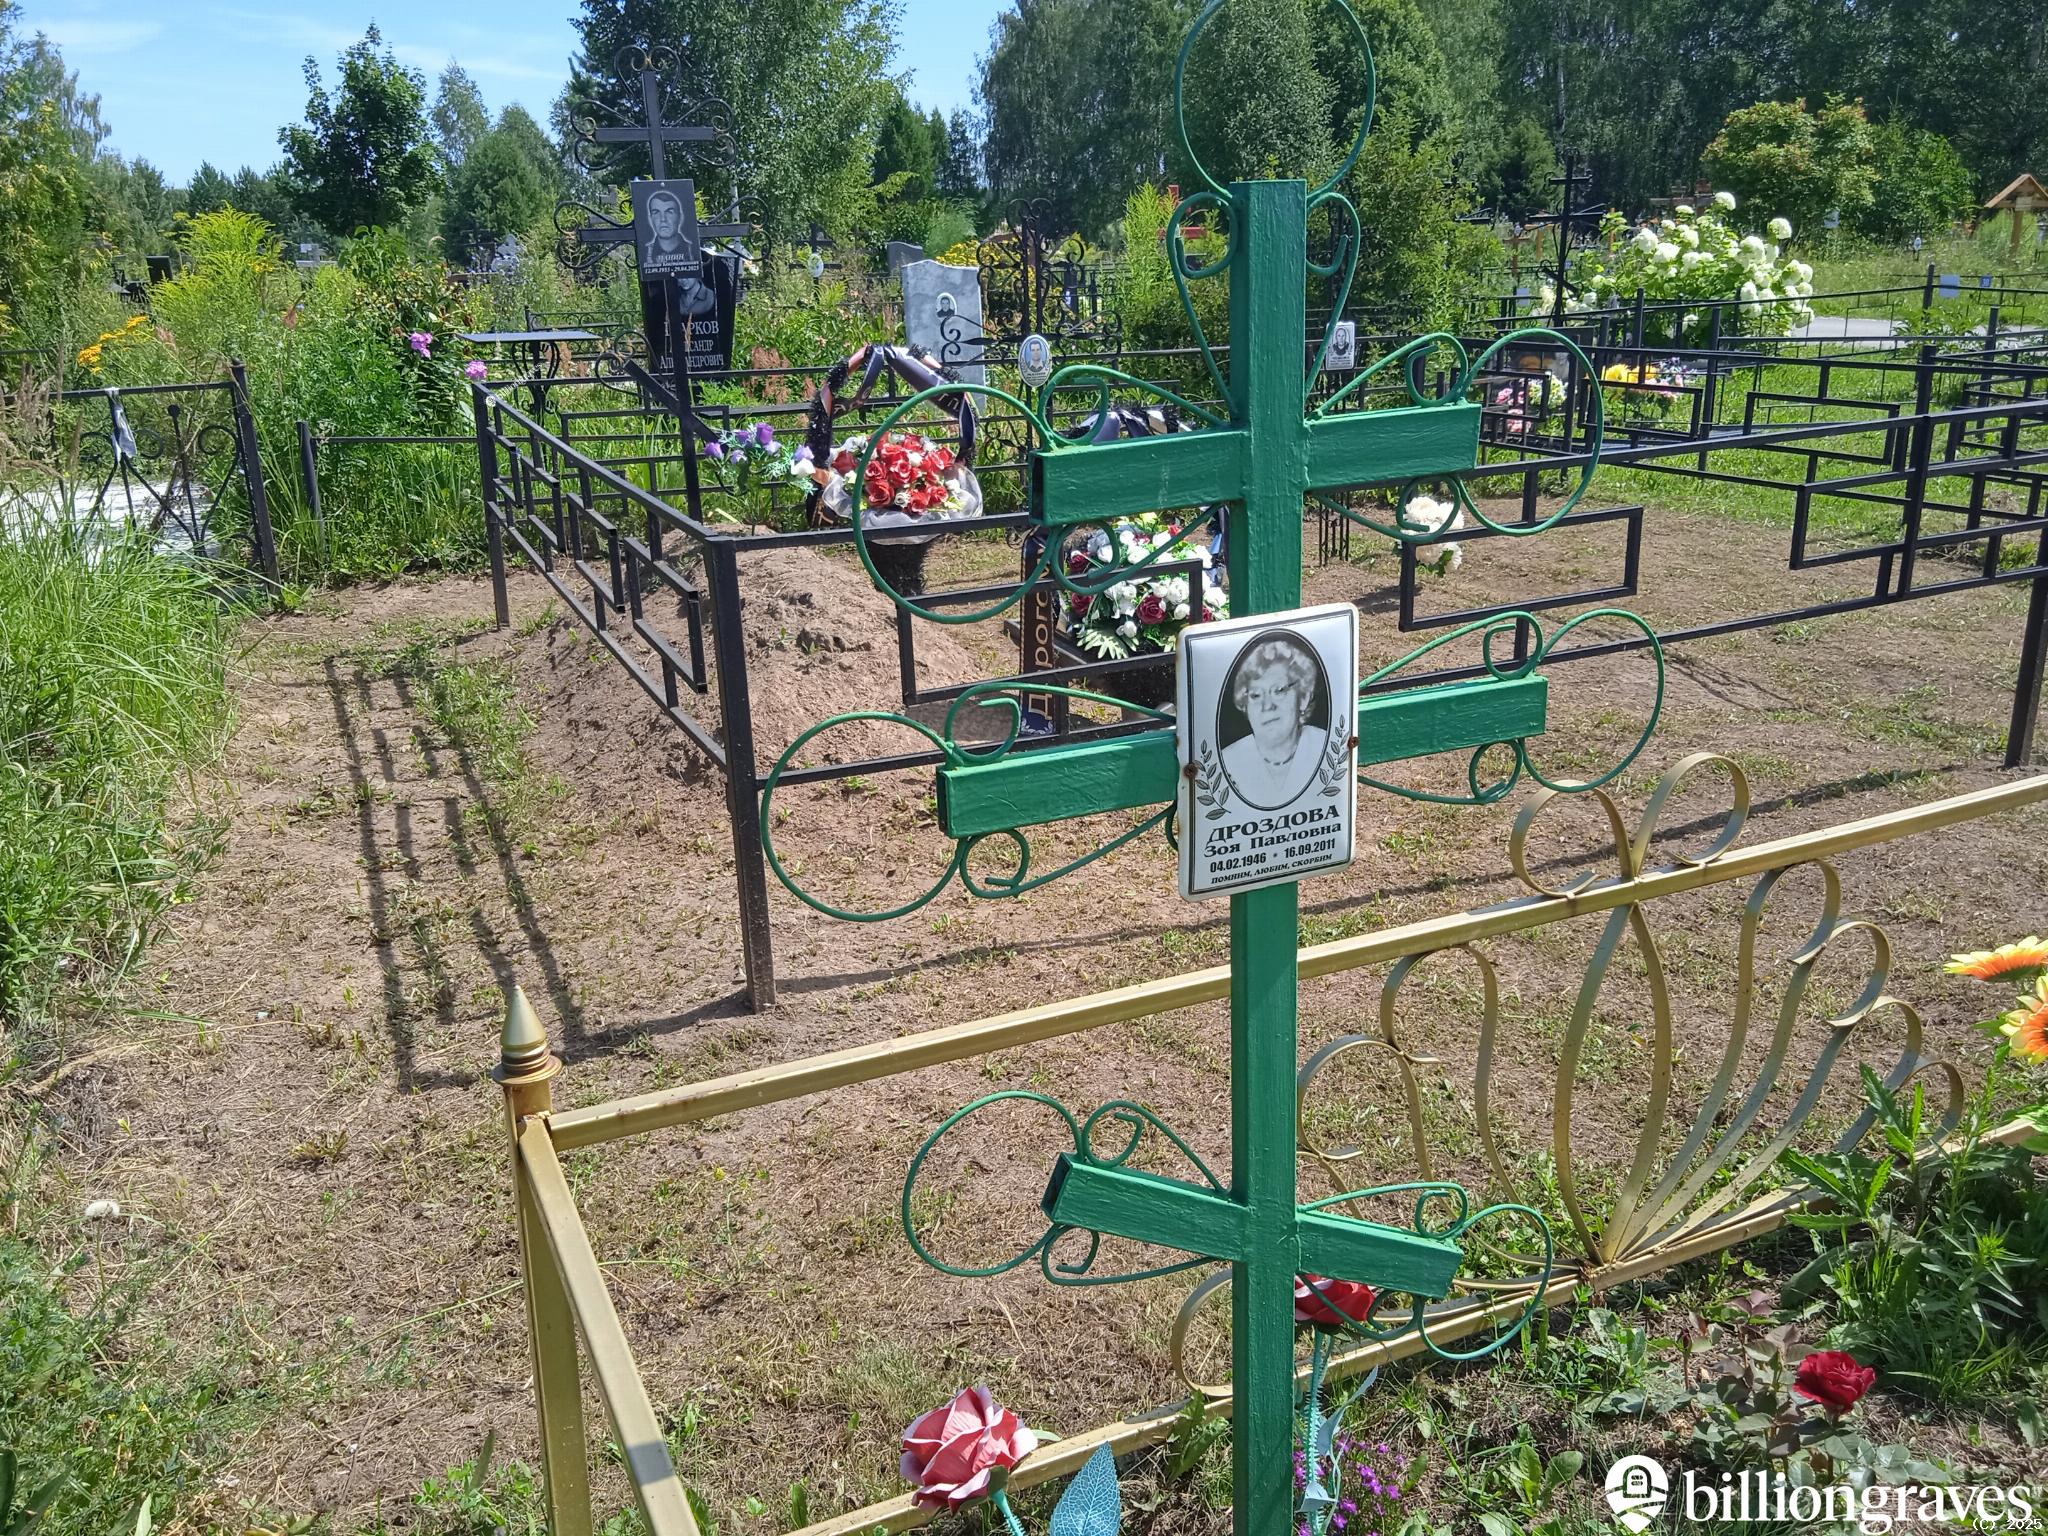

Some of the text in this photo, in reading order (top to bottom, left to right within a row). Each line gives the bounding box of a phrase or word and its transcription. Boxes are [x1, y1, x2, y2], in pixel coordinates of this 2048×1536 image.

[1204, 823, 1342, 857] Зоя Павловна
[1207, 805, 1339, 845] ДРОЗДОВА
[1210, 838, 1336, 873] 04.02.1946 16.09.2011
